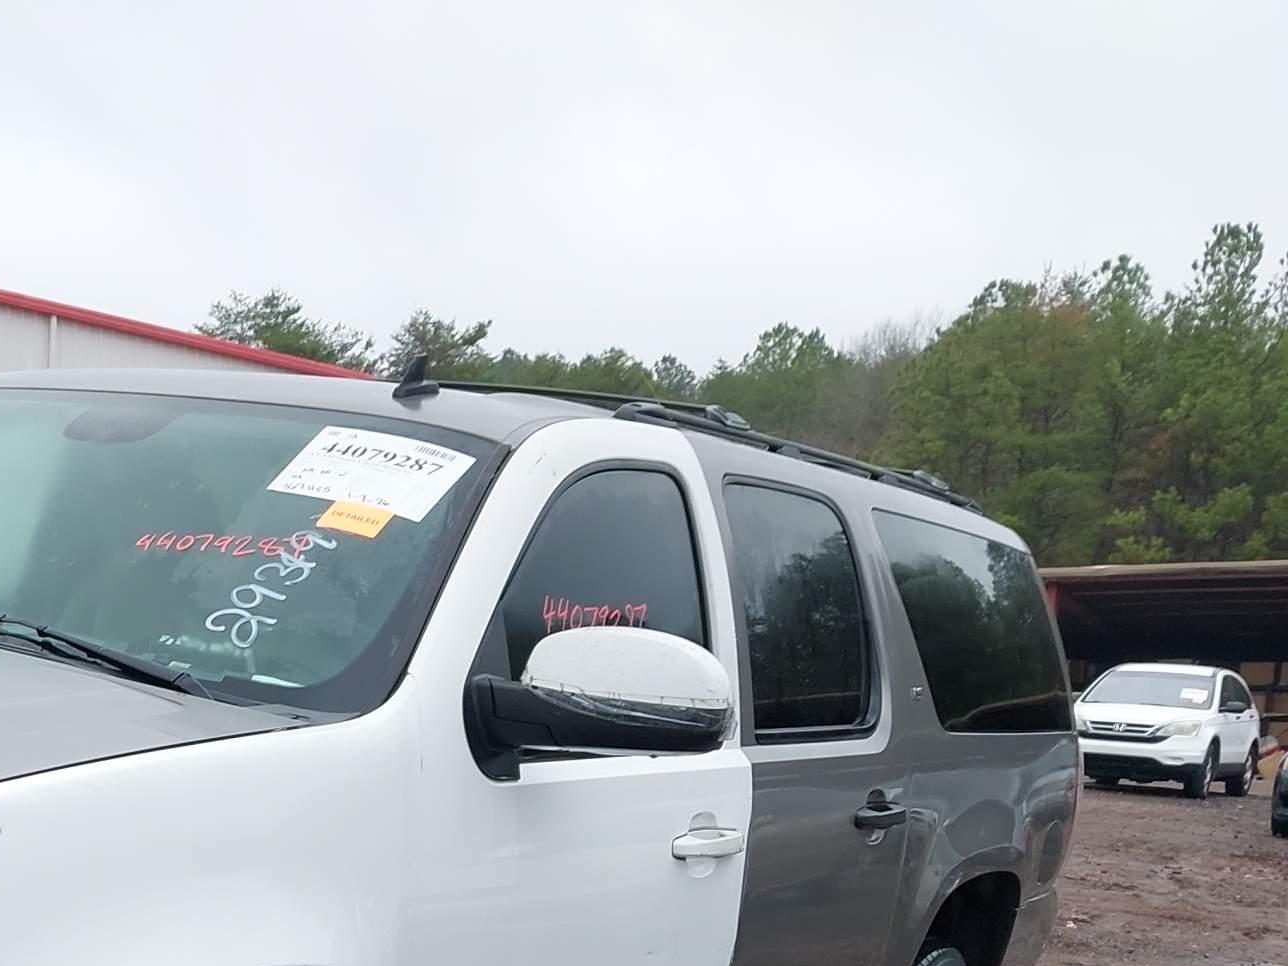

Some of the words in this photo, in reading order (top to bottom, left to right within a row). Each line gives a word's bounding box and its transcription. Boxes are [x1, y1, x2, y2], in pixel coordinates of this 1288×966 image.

[321, 441, 446, 476] 44079287
[331, 509, 381, 527] DETAILED
[136, 531, 310, 560] 44079287
